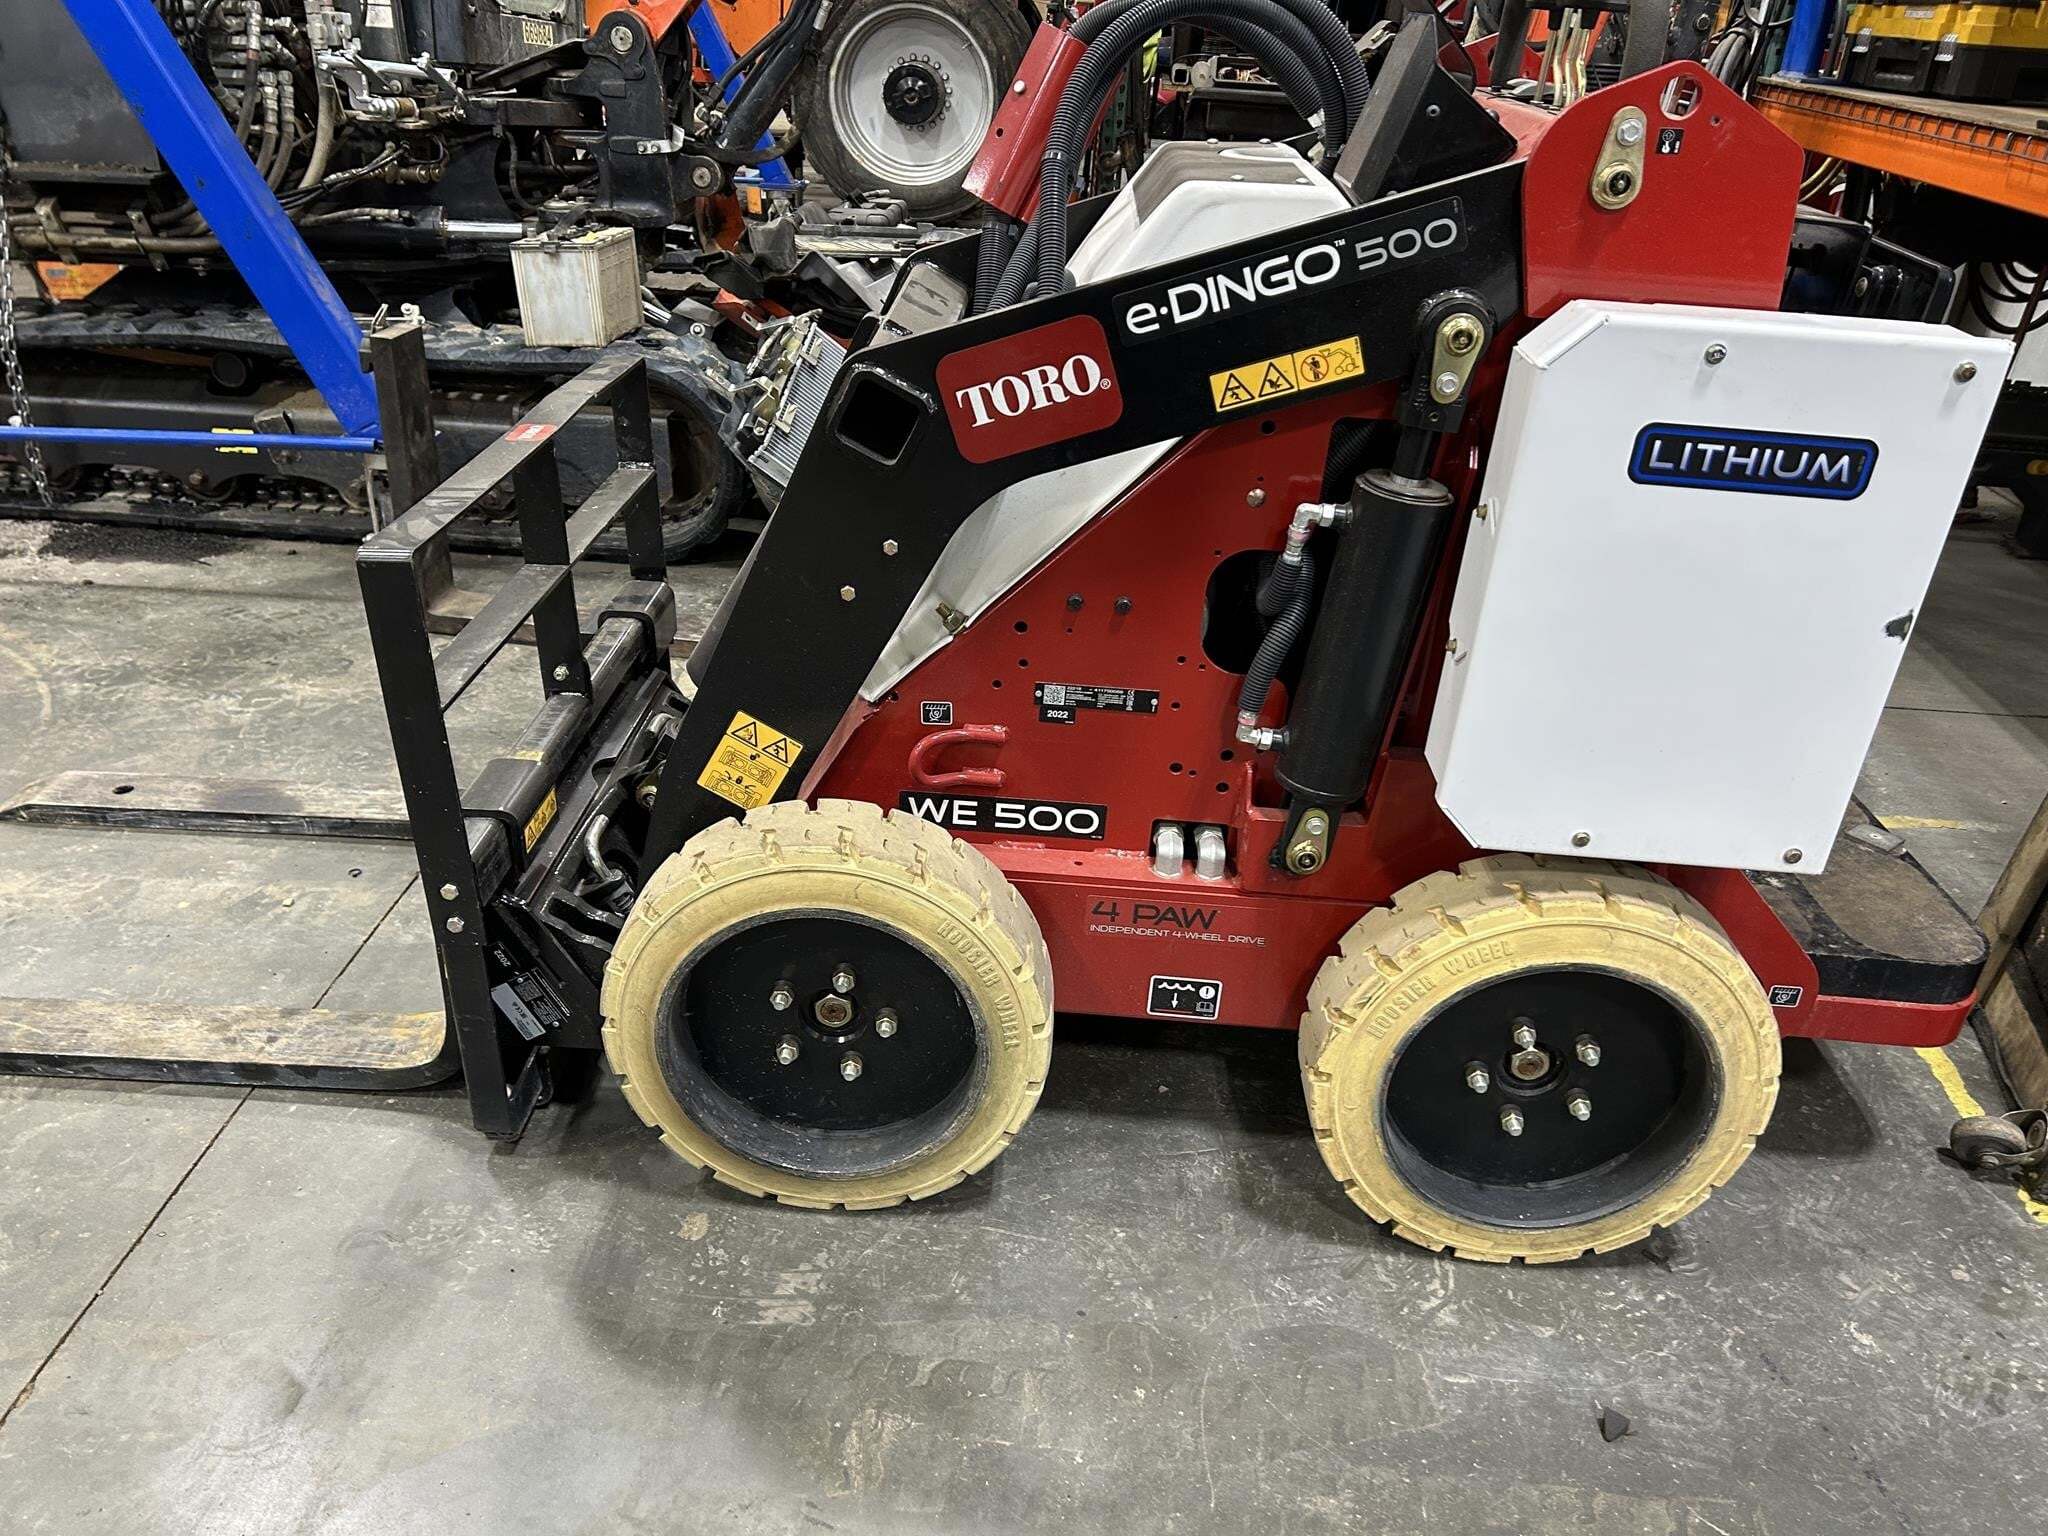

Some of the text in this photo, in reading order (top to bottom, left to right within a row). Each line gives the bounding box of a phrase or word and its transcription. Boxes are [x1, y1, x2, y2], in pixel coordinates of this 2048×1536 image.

[1354, 217, 1458, 271] 500
[1648, 439, 1851, 484] LITHIUM
[1047, 709, 1069, 719] 2022
[908, 796, 1100, 834] WE 500
[1089, 924, 1265, 945] INDEPENDENT 4-WHEEL DRIVE
[1091, 900, 1218, 930] 4 PAW
[937, 919, 1021, 1051] HOOSIER WHEEL
[1366, 940, 1513, 1040] HOOSIER WHEEL
